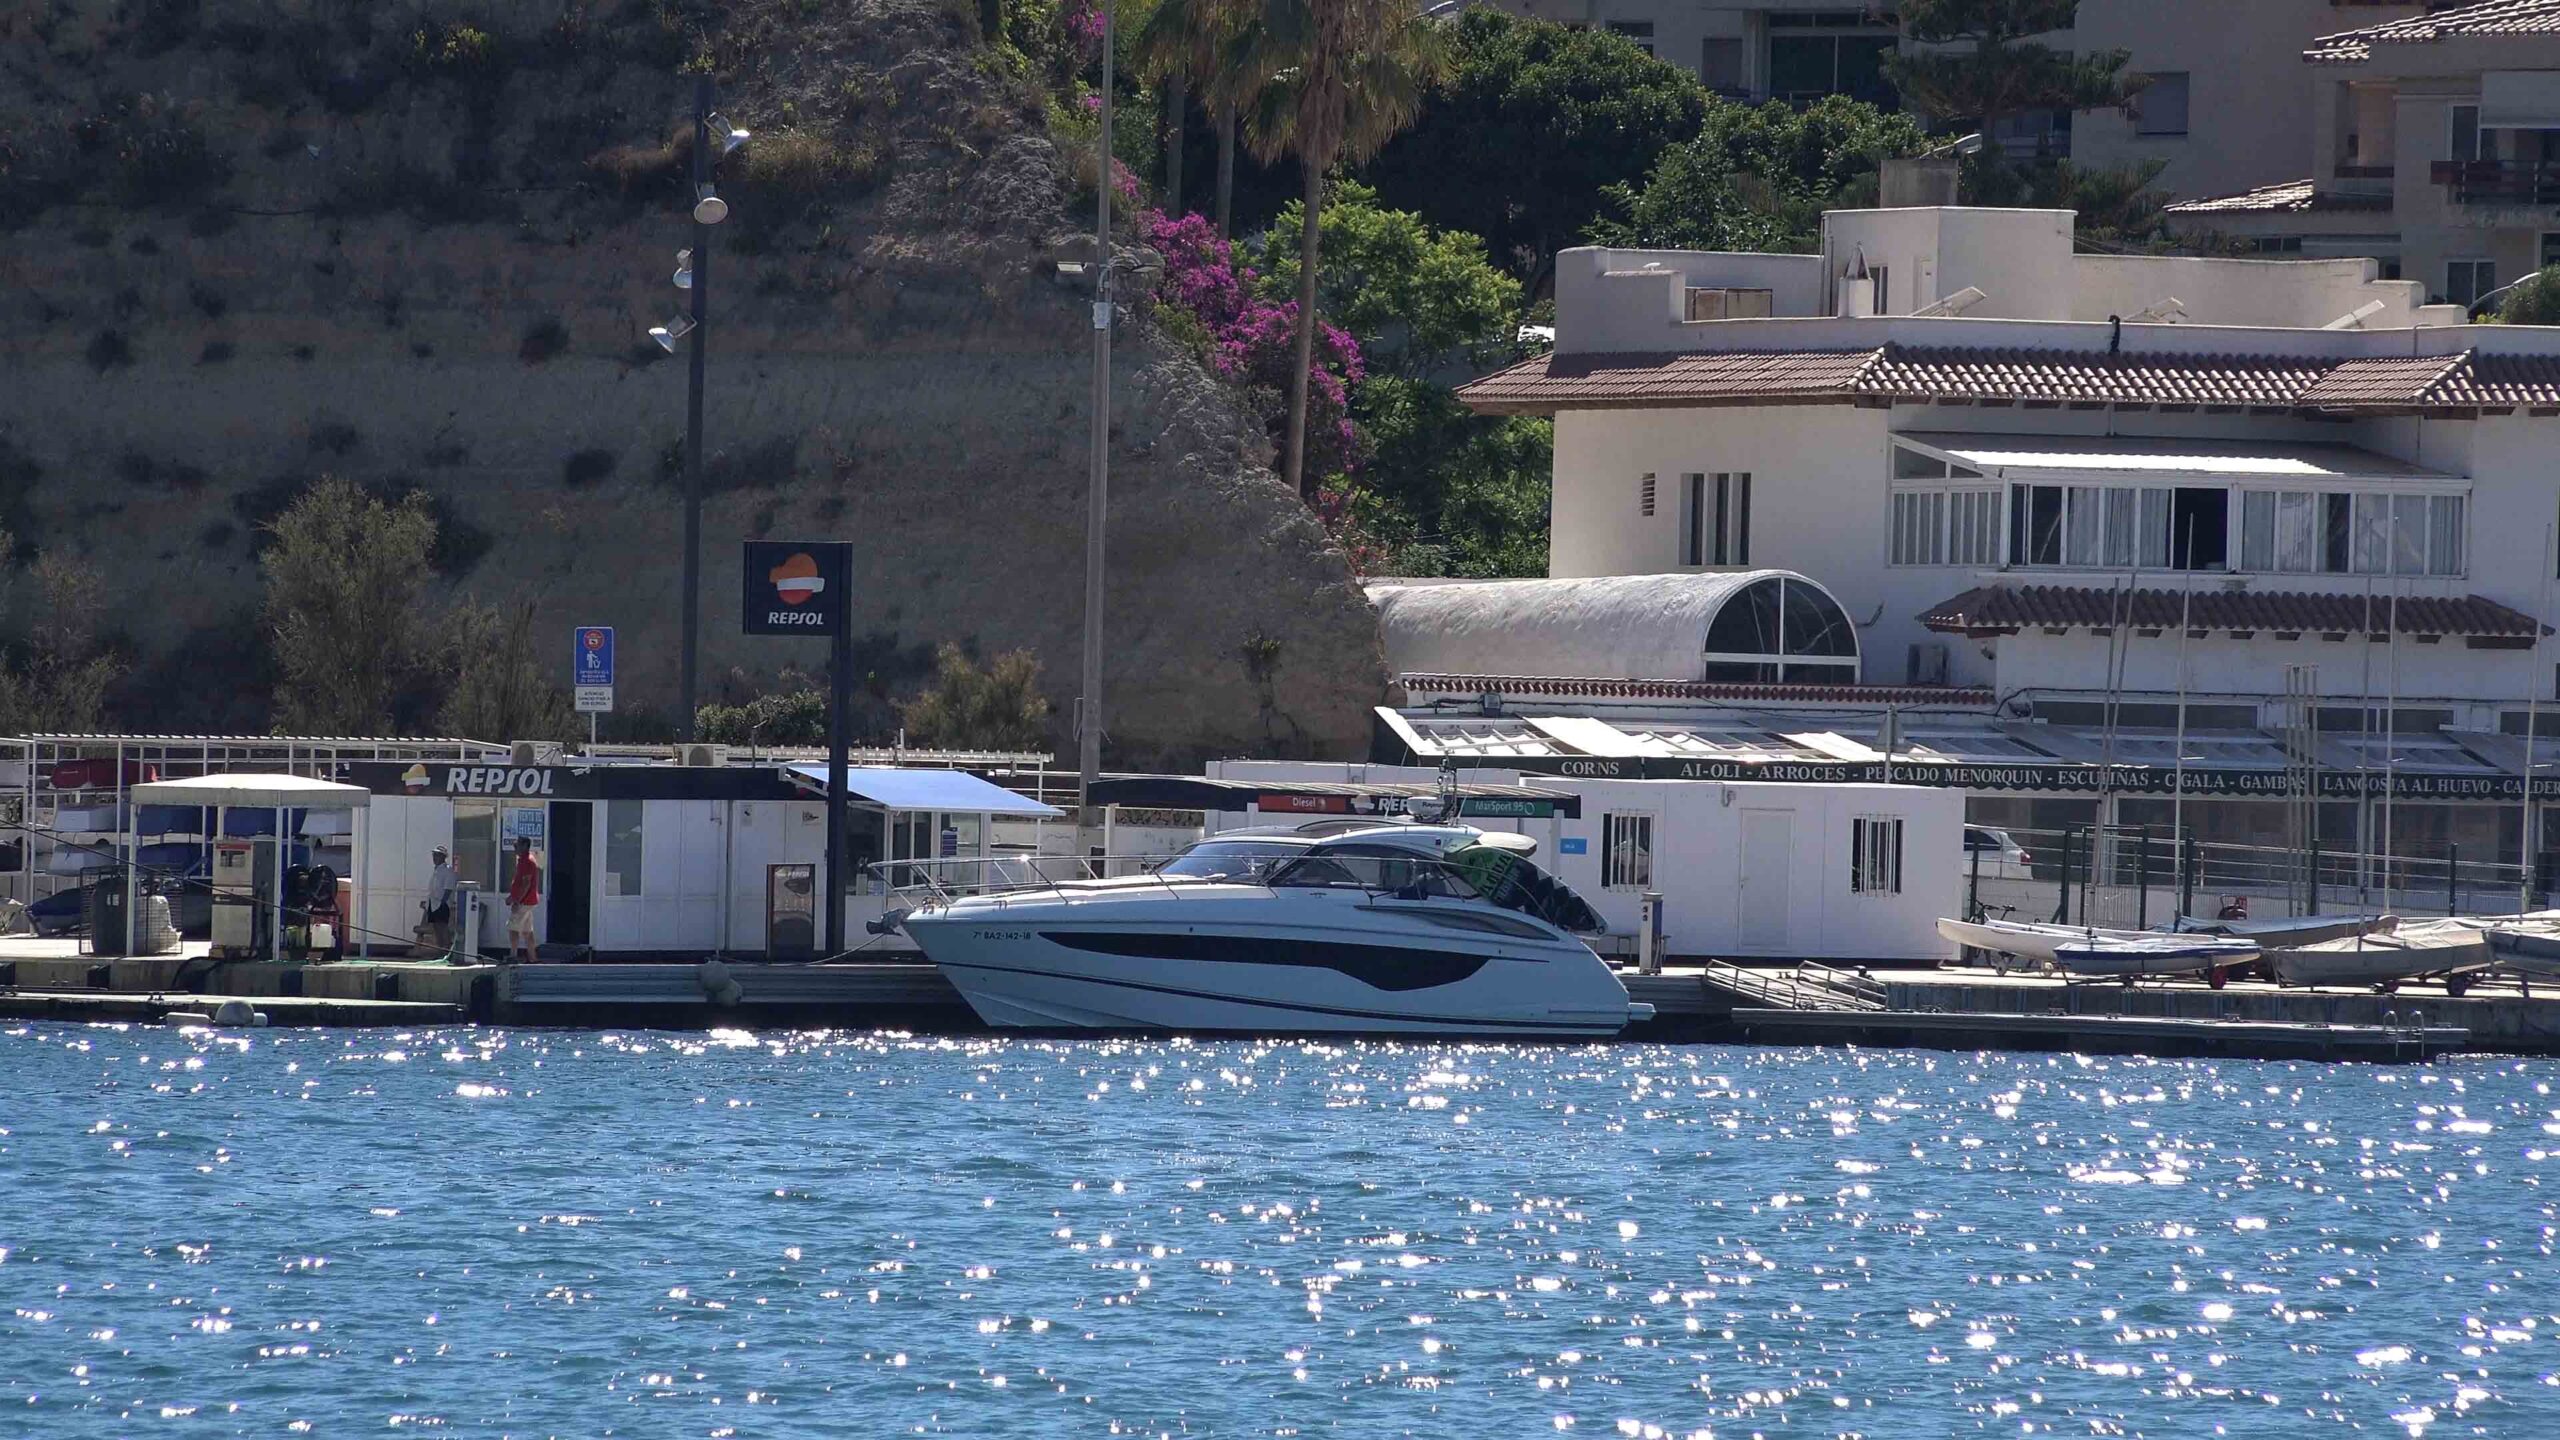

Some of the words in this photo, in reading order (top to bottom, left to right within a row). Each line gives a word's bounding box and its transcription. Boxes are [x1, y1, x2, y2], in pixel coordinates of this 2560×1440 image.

[767, 611, 824, 625] REPSOL
[446, 767, 554, 795] REPSOL
[1560, 761, 1619, 776] CORNS
[1680, 762, 1740, 778] AI-OLI
[1758, 765, 1846, 781] ARROCES
[1865, 766, 1939, 782] PESCADO
[1944, 768, 2042, 786] MENORQUIN
[2164, 773, 2225, 789] CGALA
[2411, 778, 2433, 793] AL
[2438, 779, 2491, 793] HUEVO
[1292, 796, 1317, 808] Diesel
